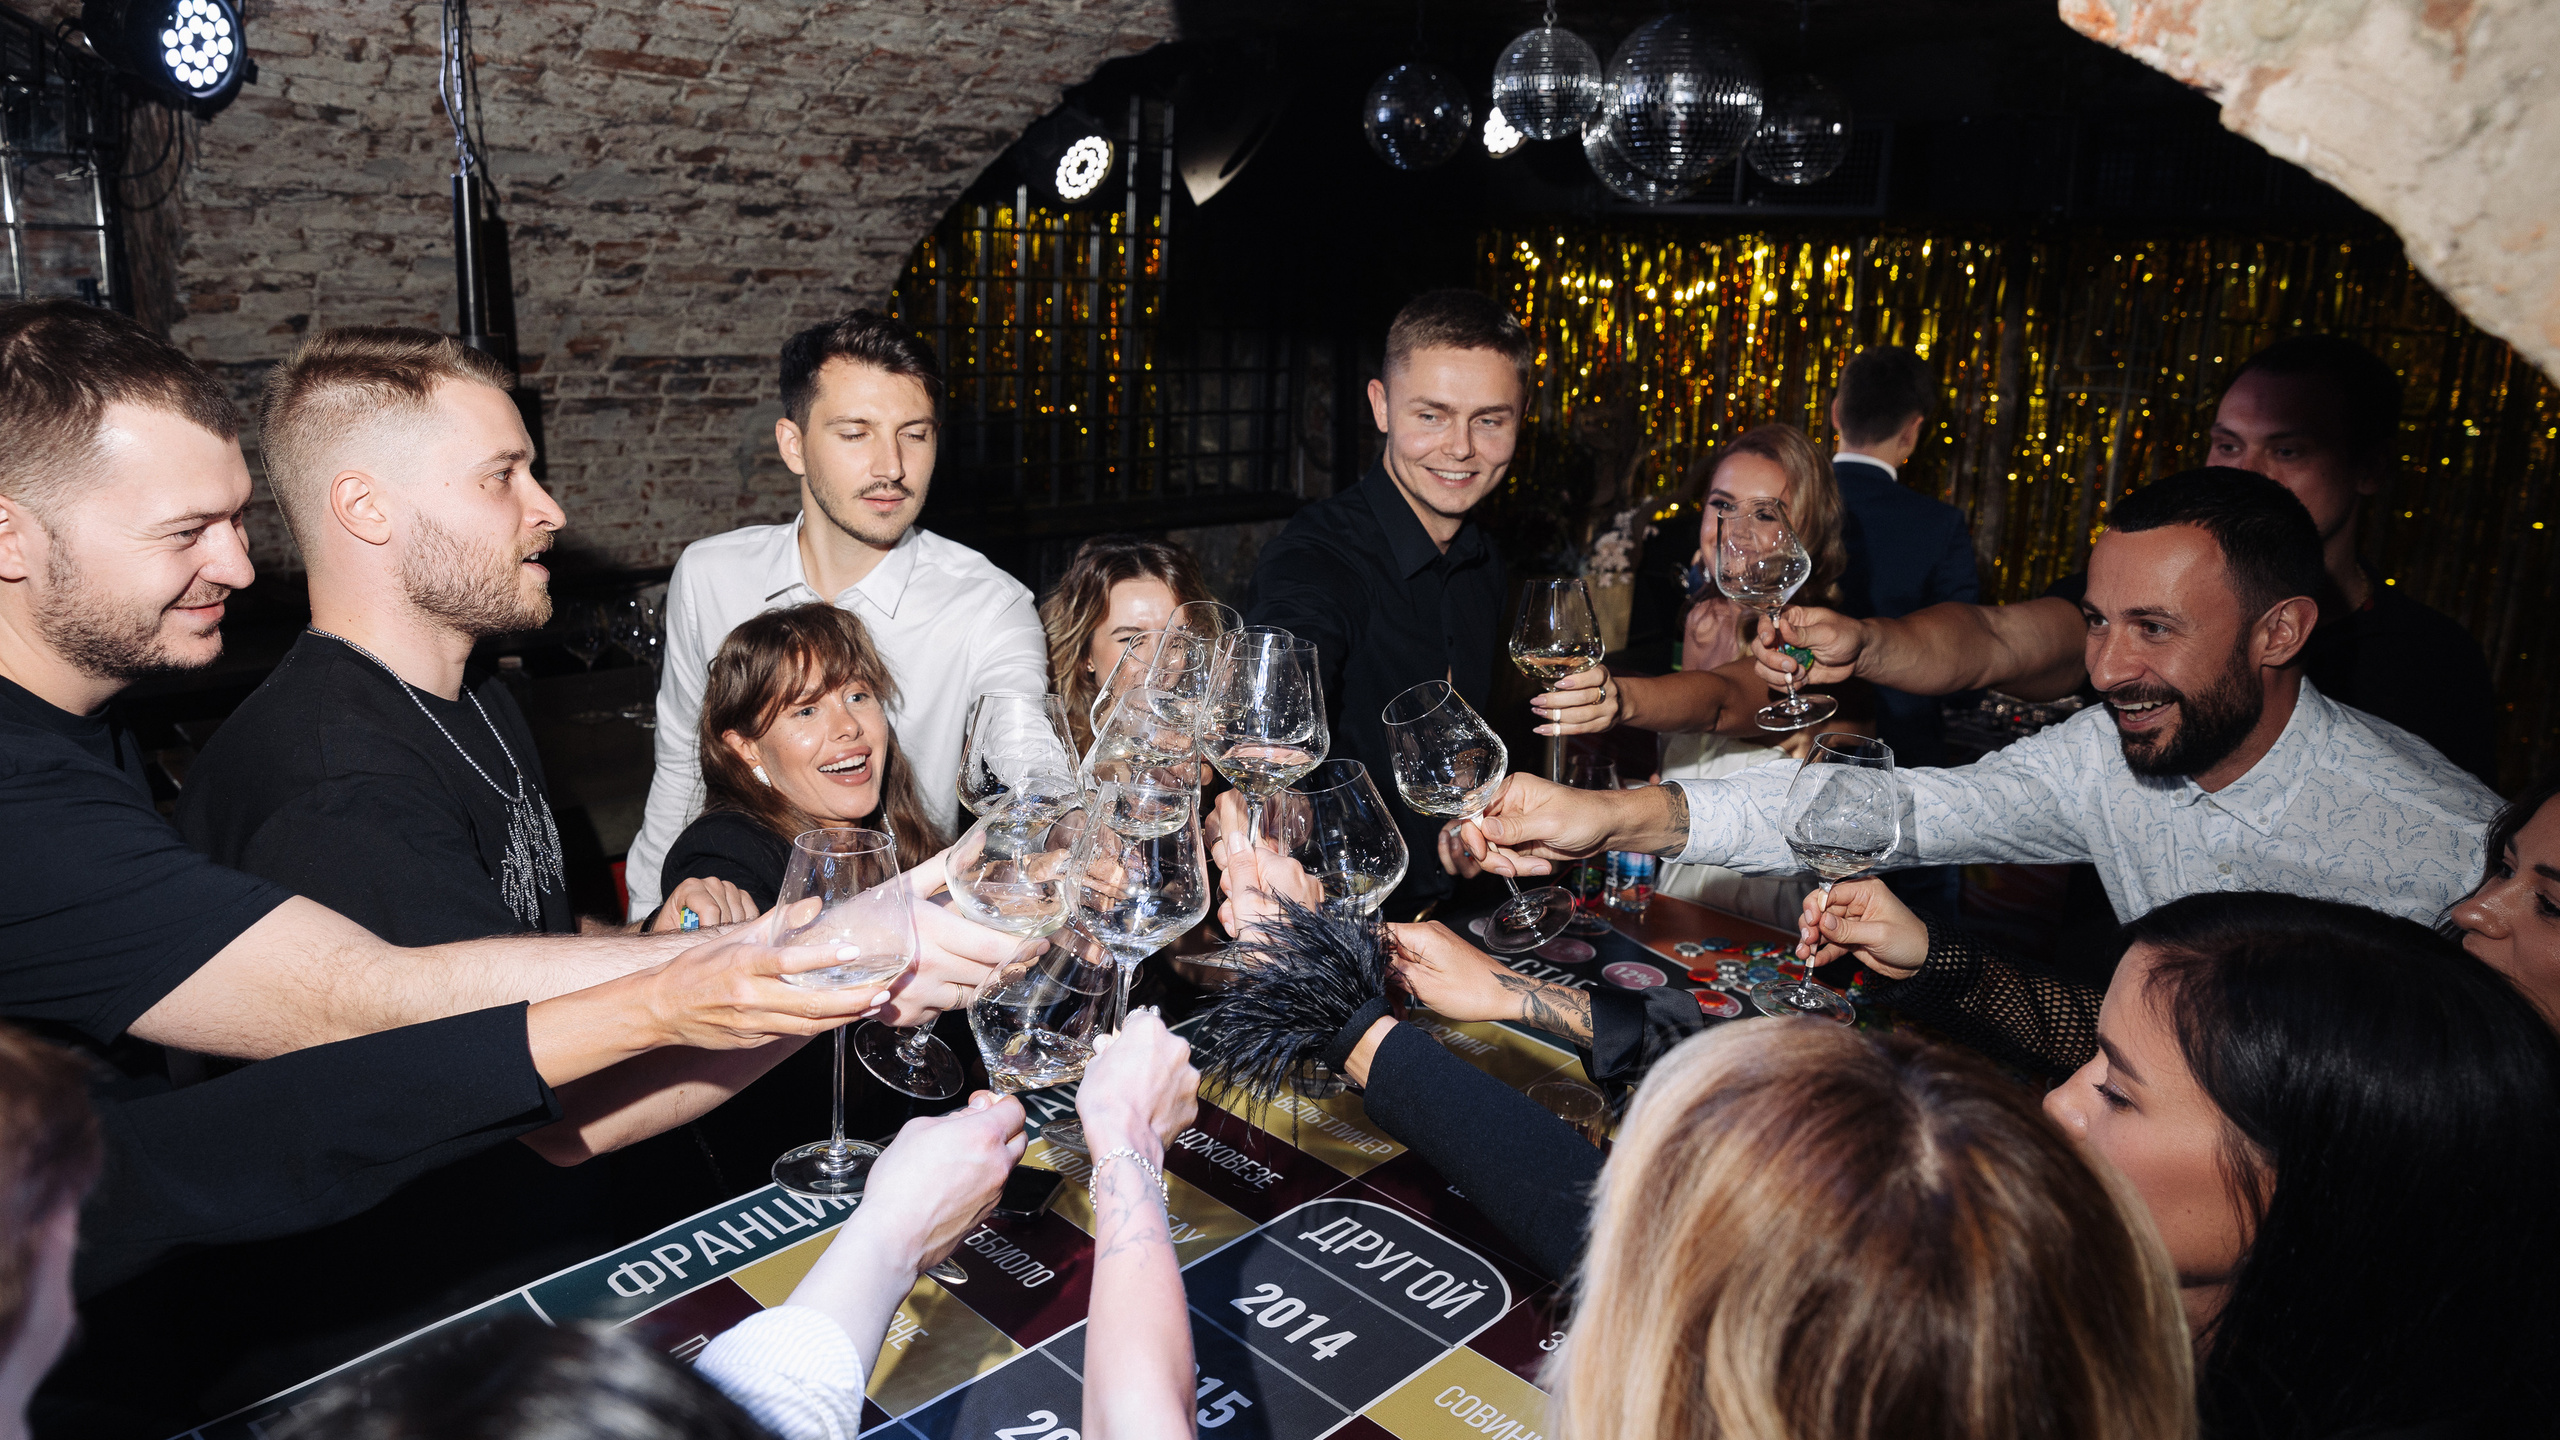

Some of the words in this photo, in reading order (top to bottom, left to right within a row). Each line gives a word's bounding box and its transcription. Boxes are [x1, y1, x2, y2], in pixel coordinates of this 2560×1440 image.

[1613, 966, 1654, 986] 12%
[1175, 1127, 1284, 1190] ДЖОВЕЗЕ
[1273, 1095, 1393, 1156] ВЕЛЬТЛИНЕР
[607, 1192, 858, 1298] ФРАНЦИ
[963, 1223, 1056, 1289] ББИОЛО
[1297, 1216, 1490, 1320] ДРУГОЙ
[1229, 1282, 1358, 1362] 2014
[1195, 1362, 1254, 1429] 15
